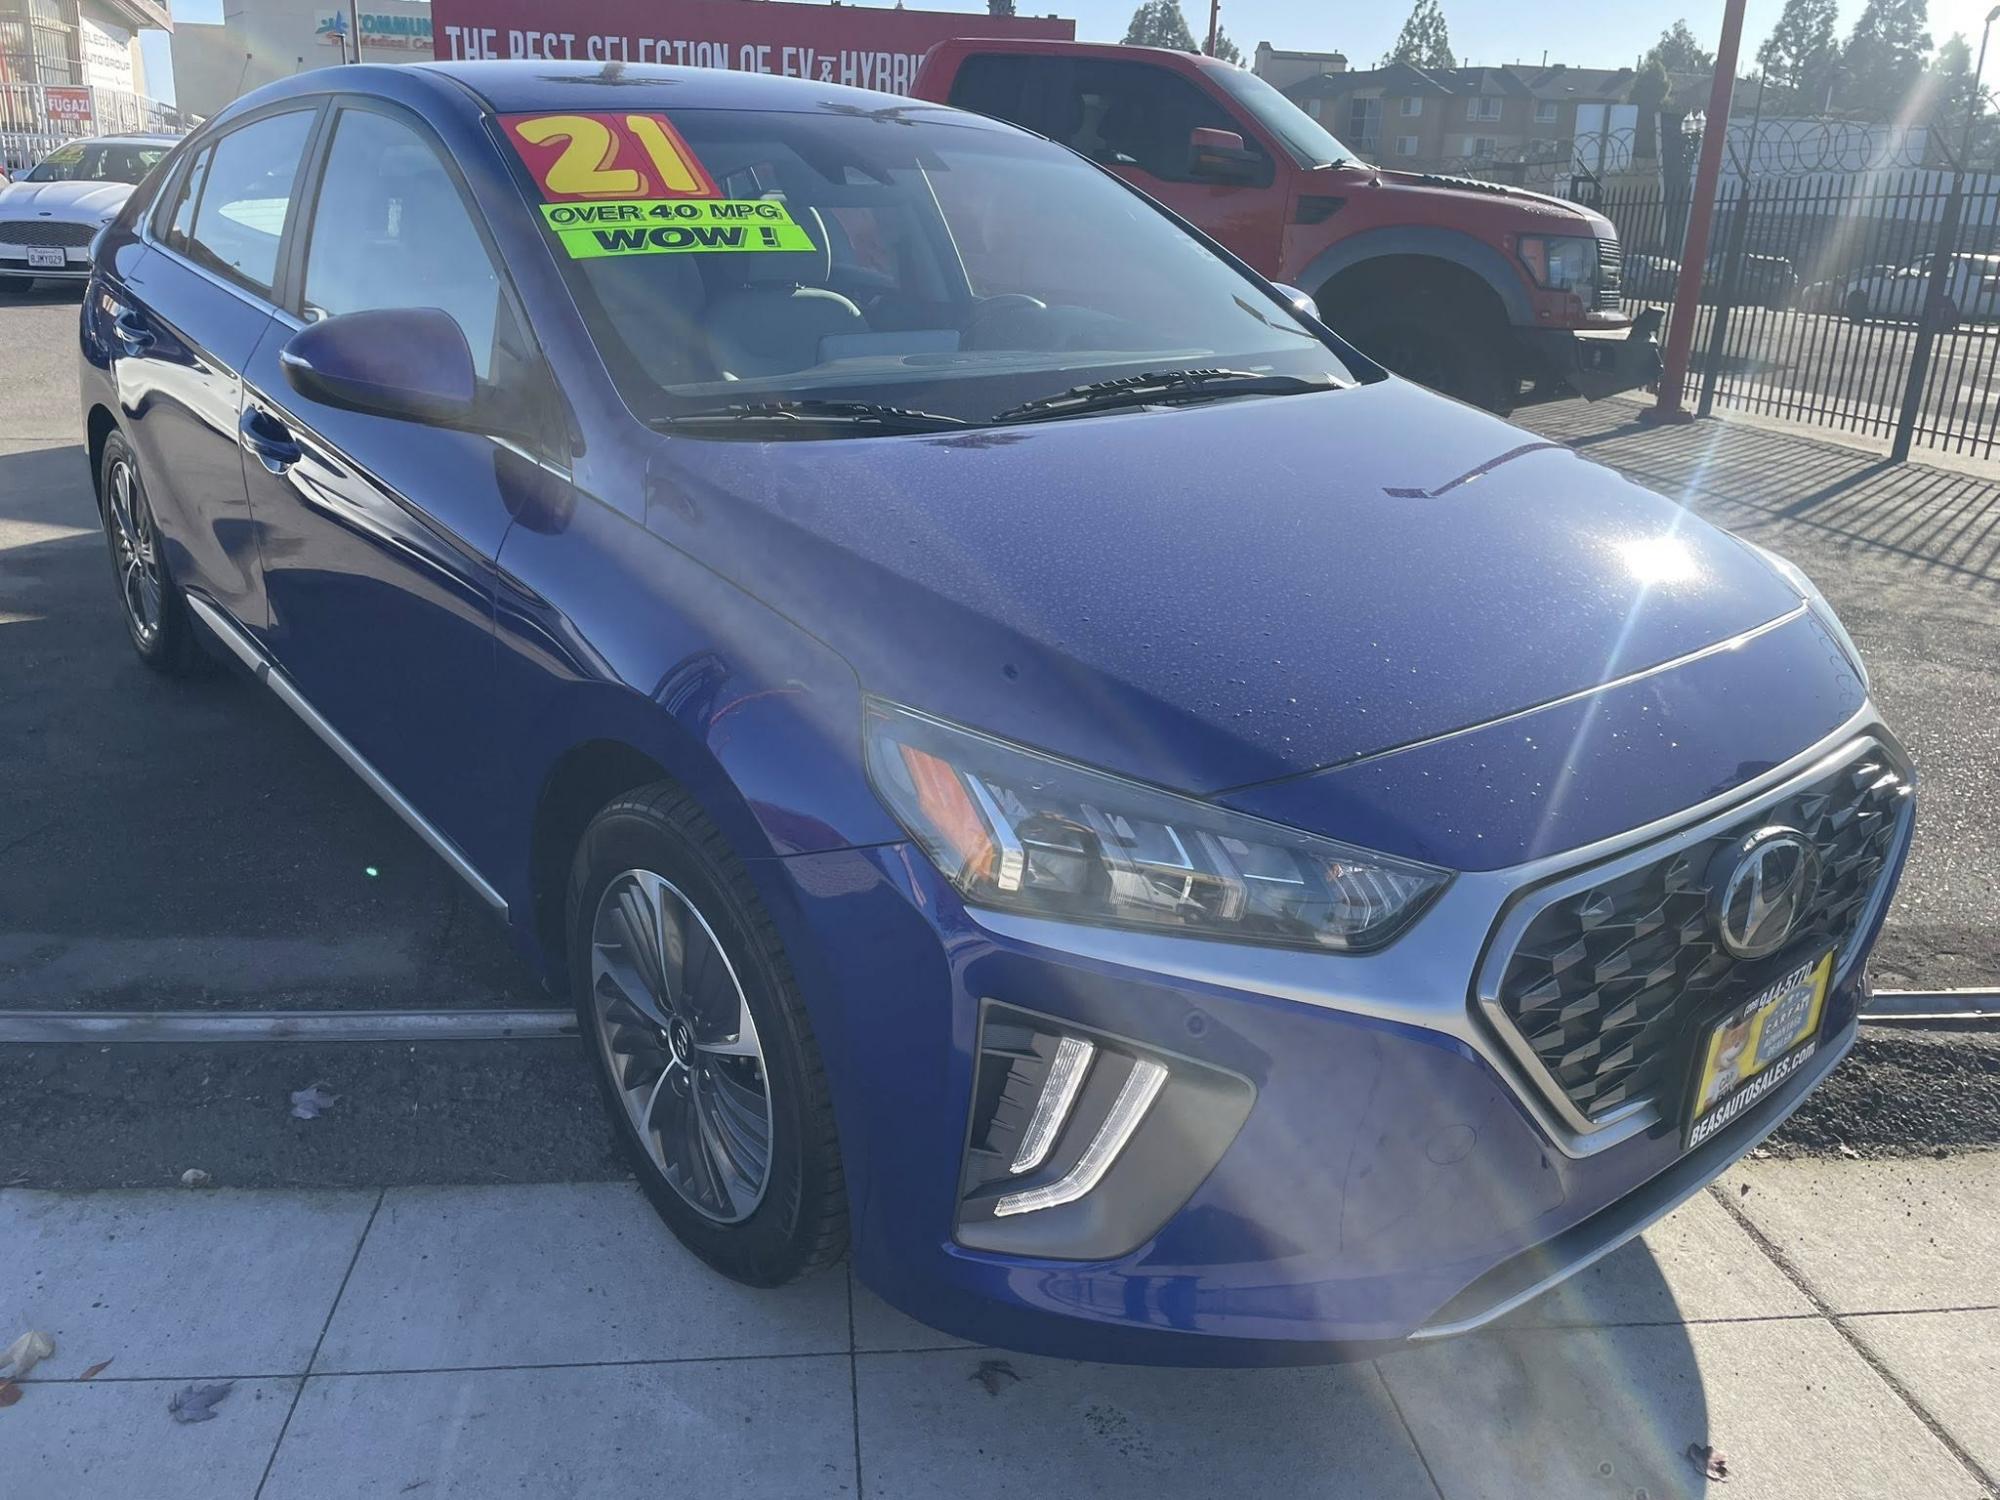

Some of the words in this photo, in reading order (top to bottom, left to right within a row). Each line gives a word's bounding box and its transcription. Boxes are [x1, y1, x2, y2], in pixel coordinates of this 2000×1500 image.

[445, 26, 497, 61] THE
[508, 30, 575, 60] BEST
[740, 44, 772, 73] OF
[782, 46, 814, 80] EV
[49, 98, 90, 112] FUGAZI
[515, 114, 708, 196] 21
[549, 203, 645, 224] OVER
[648, 203, 700, 222] 40
[710, 202, 783, 221] MPG
[592, 226, 746, 251] WOW
[759, 226, 781, 247] !
